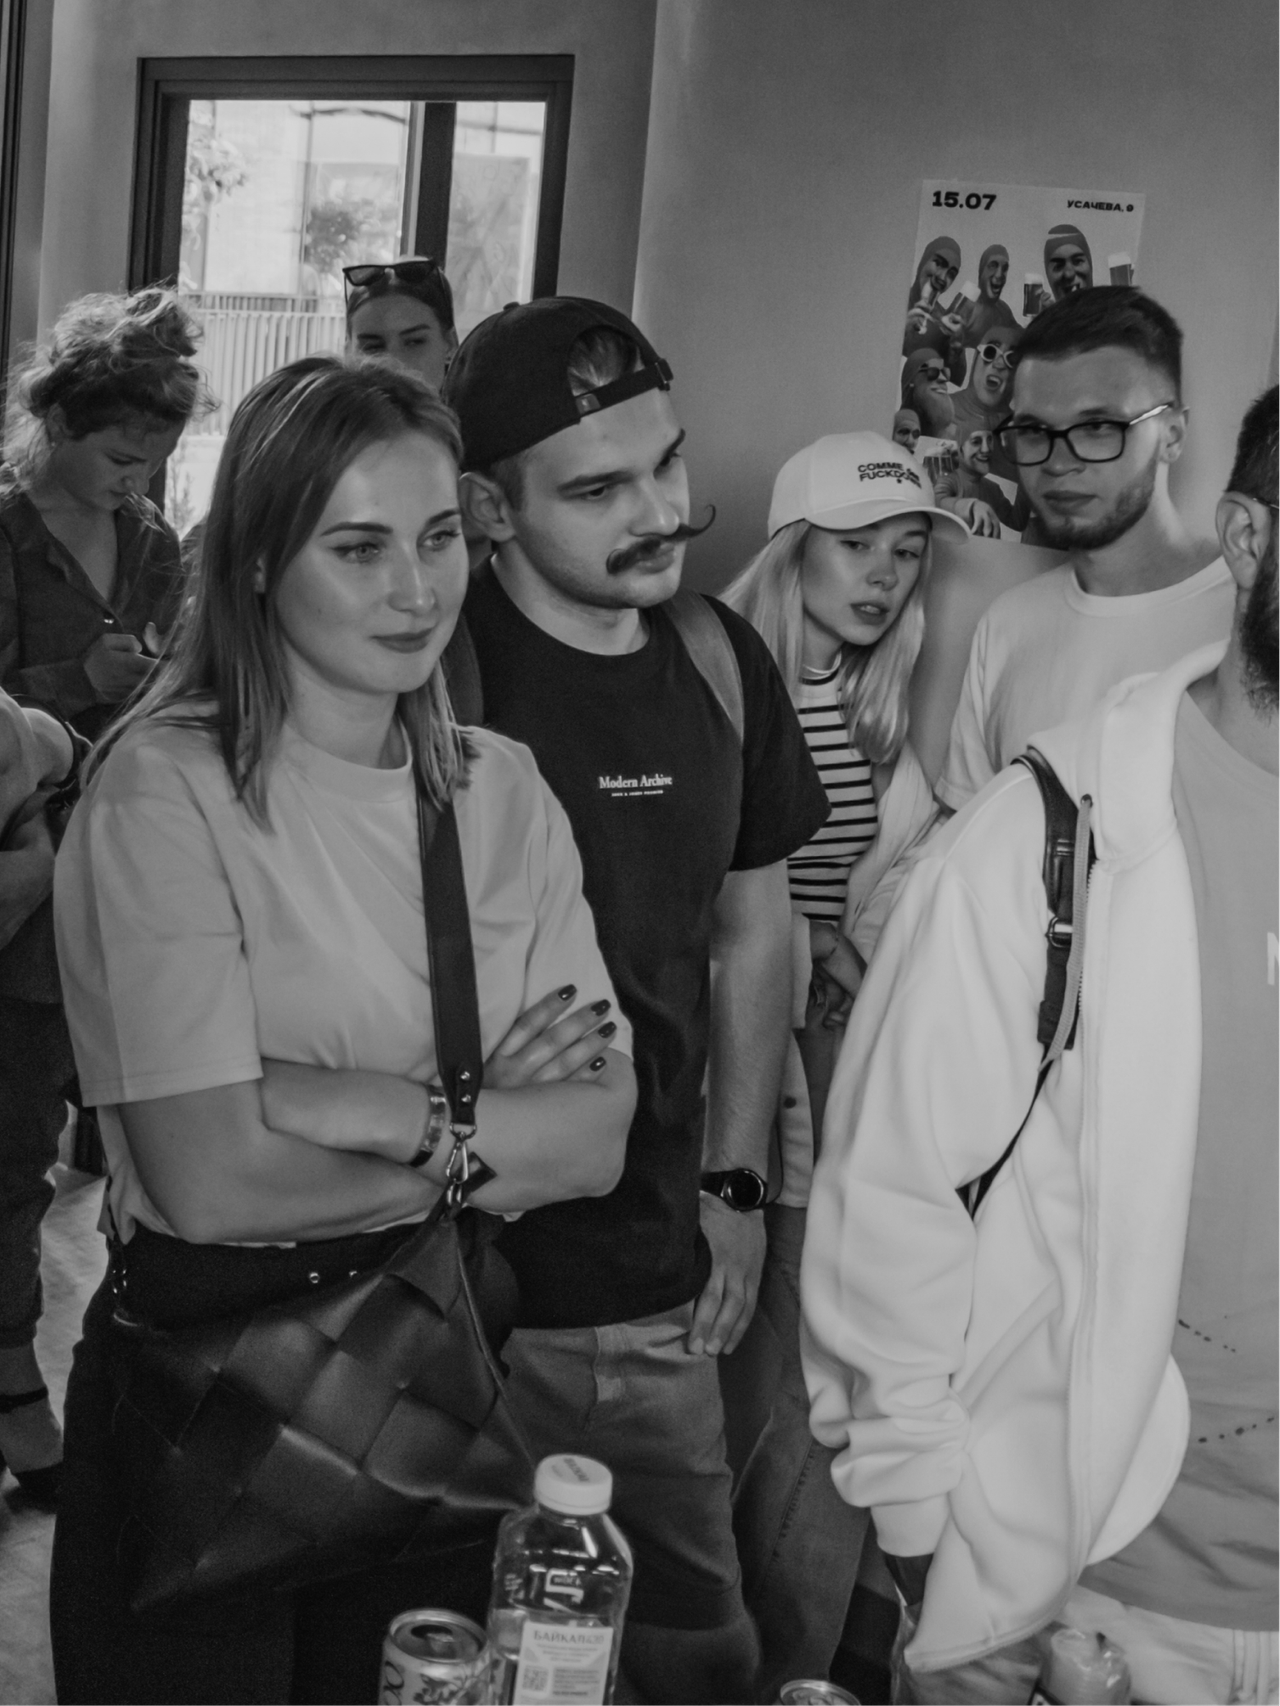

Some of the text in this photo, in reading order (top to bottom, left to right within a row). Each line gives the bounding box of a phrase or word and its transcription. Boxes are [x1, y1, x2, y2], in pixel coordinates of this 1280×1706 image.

[932, 190, 997, 211] 15.07
[599, 773, 673, 789] Modern Archive
